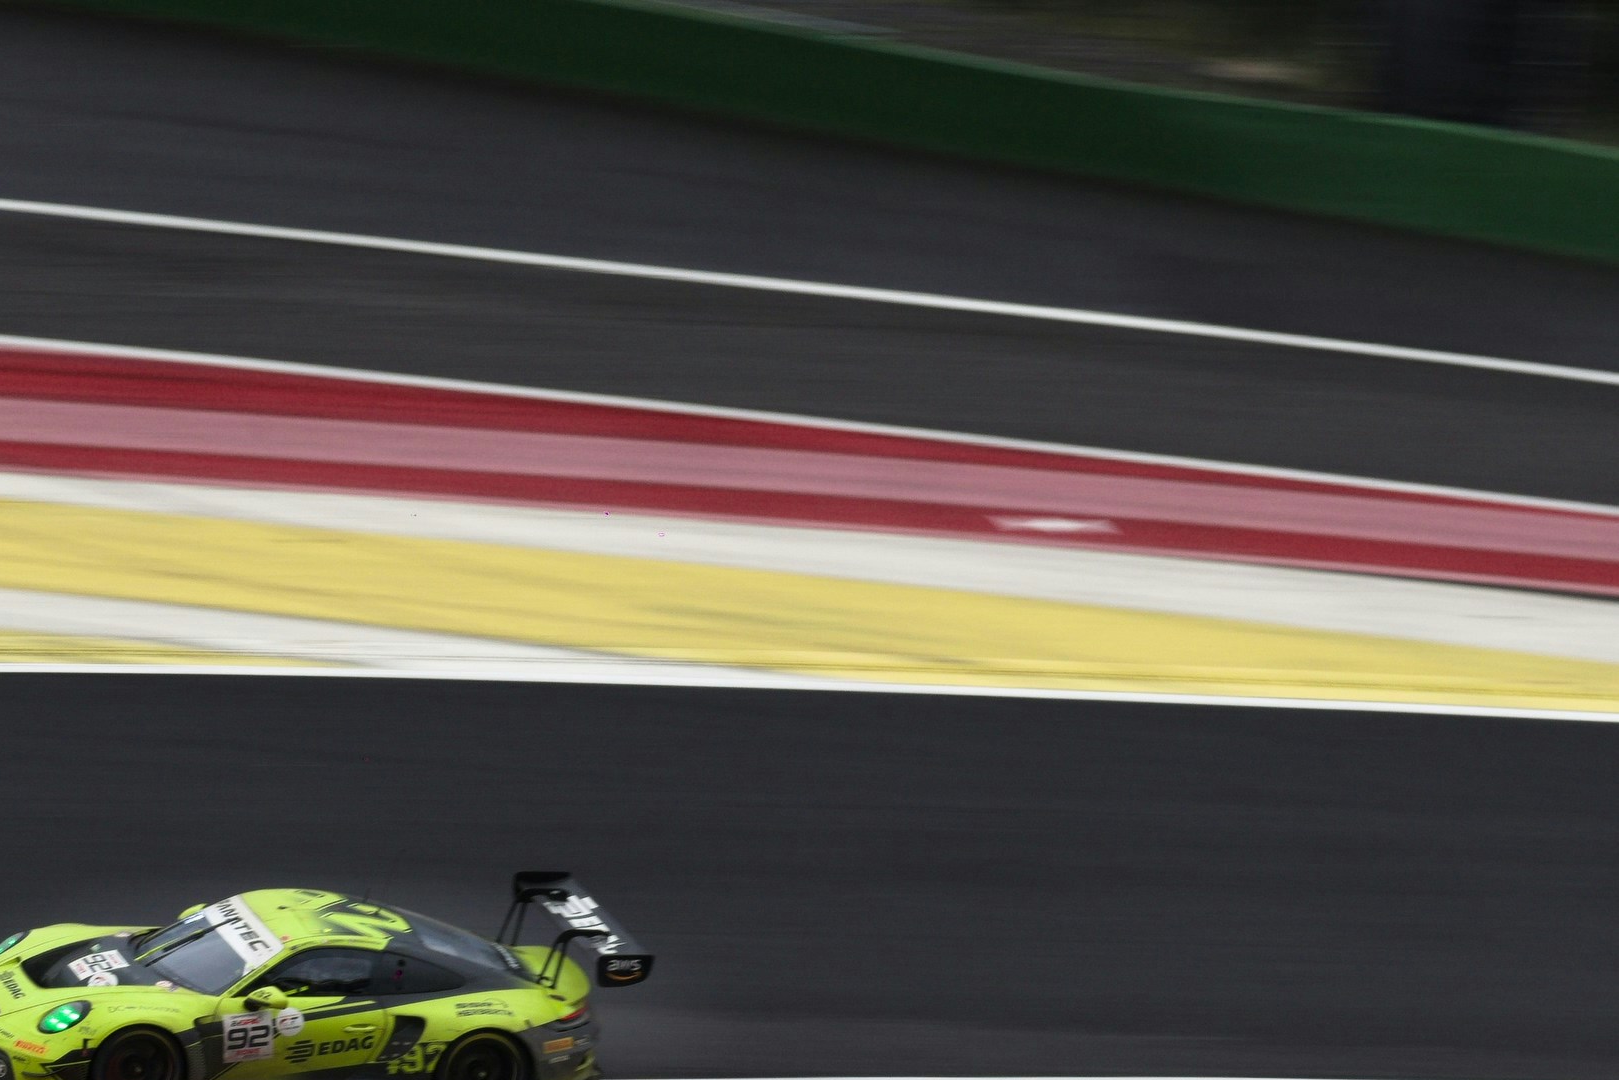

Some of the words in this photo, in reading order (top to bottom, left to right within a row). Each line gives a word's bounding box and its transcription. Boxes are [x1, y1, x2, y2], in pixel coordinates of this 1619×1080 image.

[84, 954, 113, 973] 92
[607, 959, 642, 971] aws
[2, 978, 26, 999] EDAG
[226, 1025, 269, 1050] 92
[317, 1036, 374, 1055] EDAG
